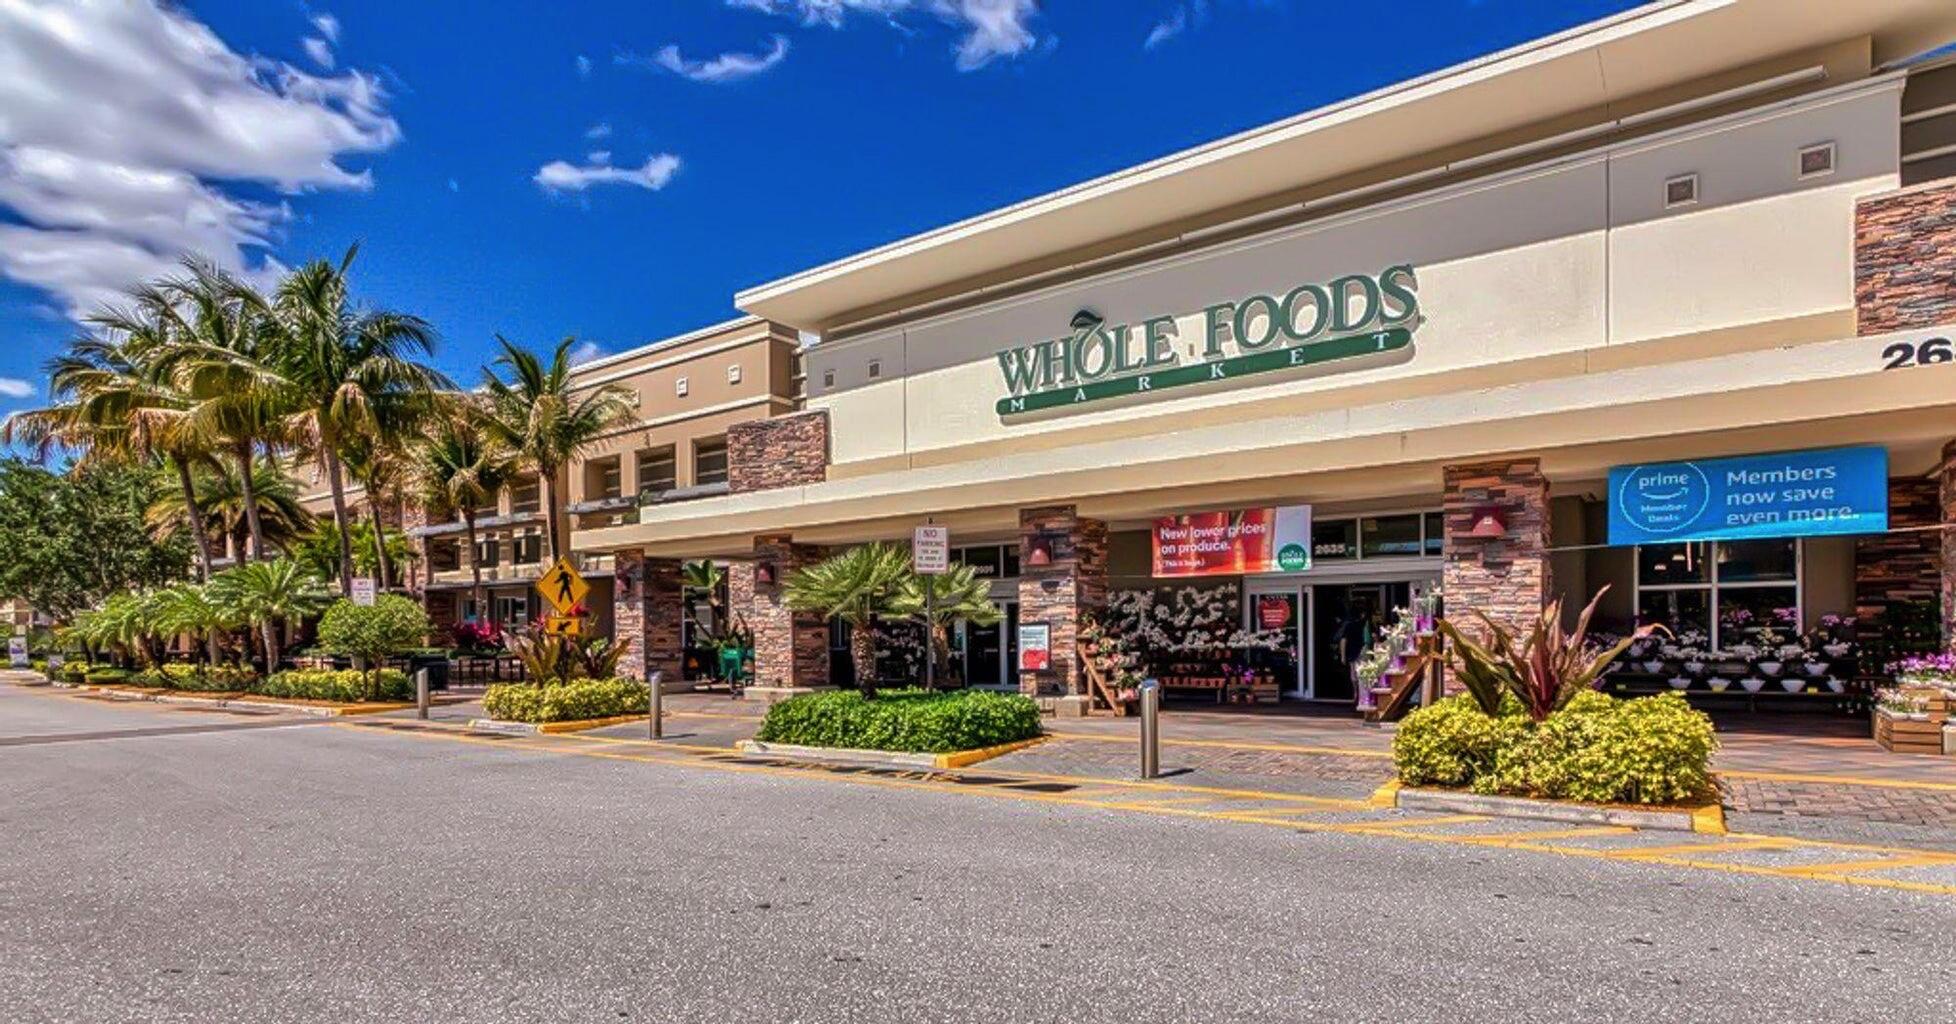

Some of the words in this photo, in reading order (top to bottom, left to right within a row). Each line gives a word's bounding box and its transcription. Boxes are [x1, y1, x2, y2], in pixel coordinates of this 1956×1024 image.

[998, 311, 1178, 397] WHOLE
[1203, 264, 1418, 357] FOODS
[1882, 337, 1956, 370] 26
[1010, 332, 1390, 412] MARKET
[1639, 472, 1689, 489] prime
[1727, 465, 1837, 486] Members
[1727, 490, 1775, 506] now
[1782, 485, 1834, 502] save
[1727, 511, 1779, 525] even
[1787, 505, 1860, 521] more.
[923, 530, 937, 538] NO
[1161, 527, 1187, 540] New
[1190, 525, 1224, 538] lower
[1228, 521, 1266, 538] prices
[1161, 545, 1176, 554] on
[1179, 540, 1232, 556] produce.
